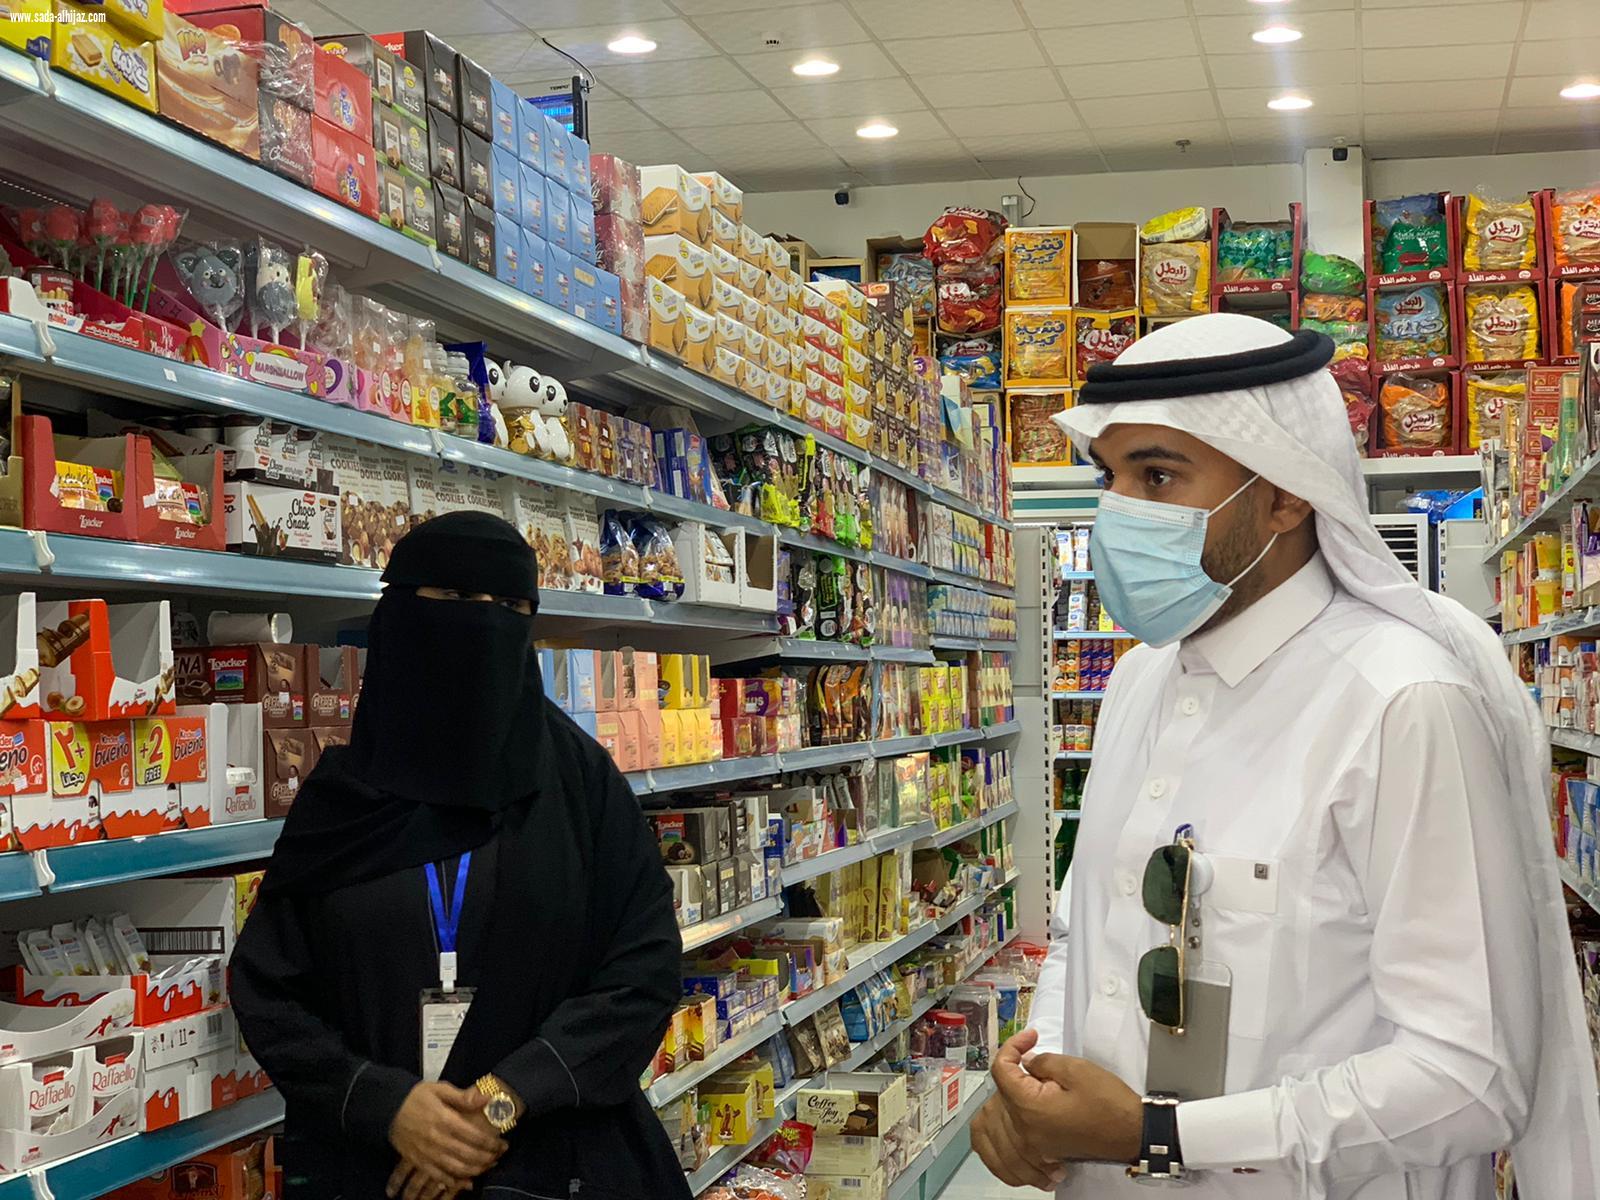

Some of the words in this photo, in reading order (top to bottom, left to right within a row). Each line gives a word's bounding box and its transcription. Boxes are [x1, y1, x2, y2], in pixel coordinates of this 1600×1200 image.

[436, 491, 465, 504] COOKIES
[291, 498, 316, 517] Choco
[286, 512, 310, 530] Snack
[208, 658, 248, 671] Loacker
[94, 742, 130, 770] bueno
[174, 736, 205, 761] bueno
[144, 765, 163, 785] FREE
[225, 795, 257, 815] Raffaello
[92, 1064, 136, 1091] Raffaello
[29, 1081, 76, 1110] Raffaello
[807, 1095, 836, 1109] Coffee
[818, 1106, 840, 1120] Joy
